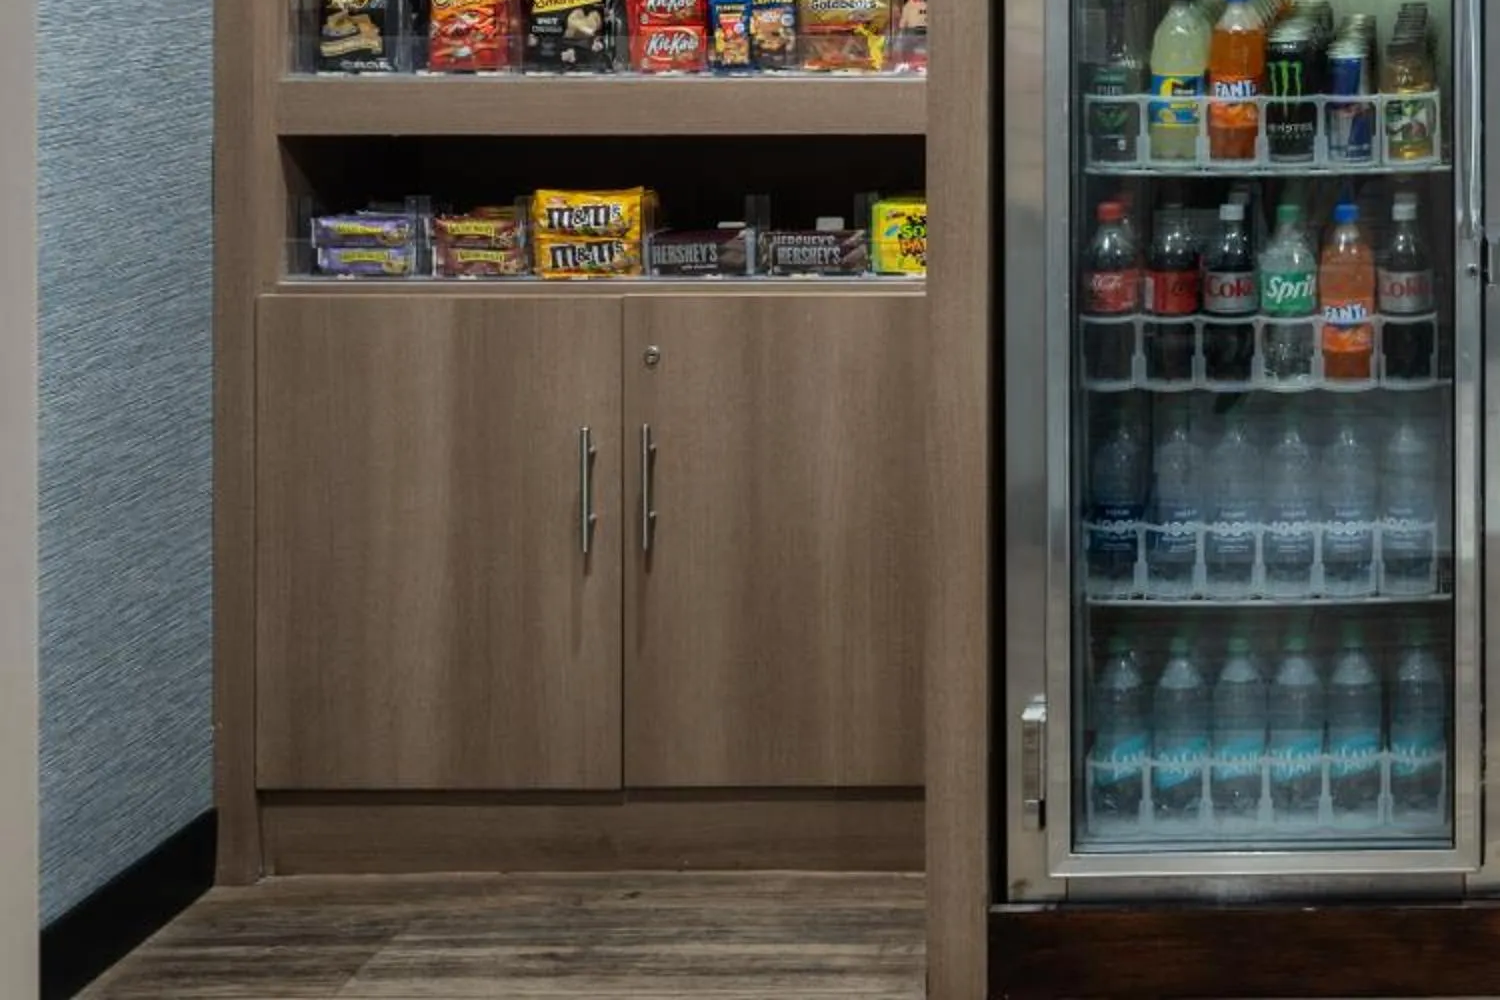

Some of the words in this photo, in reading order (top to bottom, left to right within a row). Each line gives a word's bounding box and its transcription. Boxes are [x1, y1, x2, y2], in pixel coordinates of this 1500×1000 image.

[652, 243, 718, 264] HERSHEY'S
[1267, 275, 1314, 304] Spri
[1324, 303, 1367, 321] FANT
